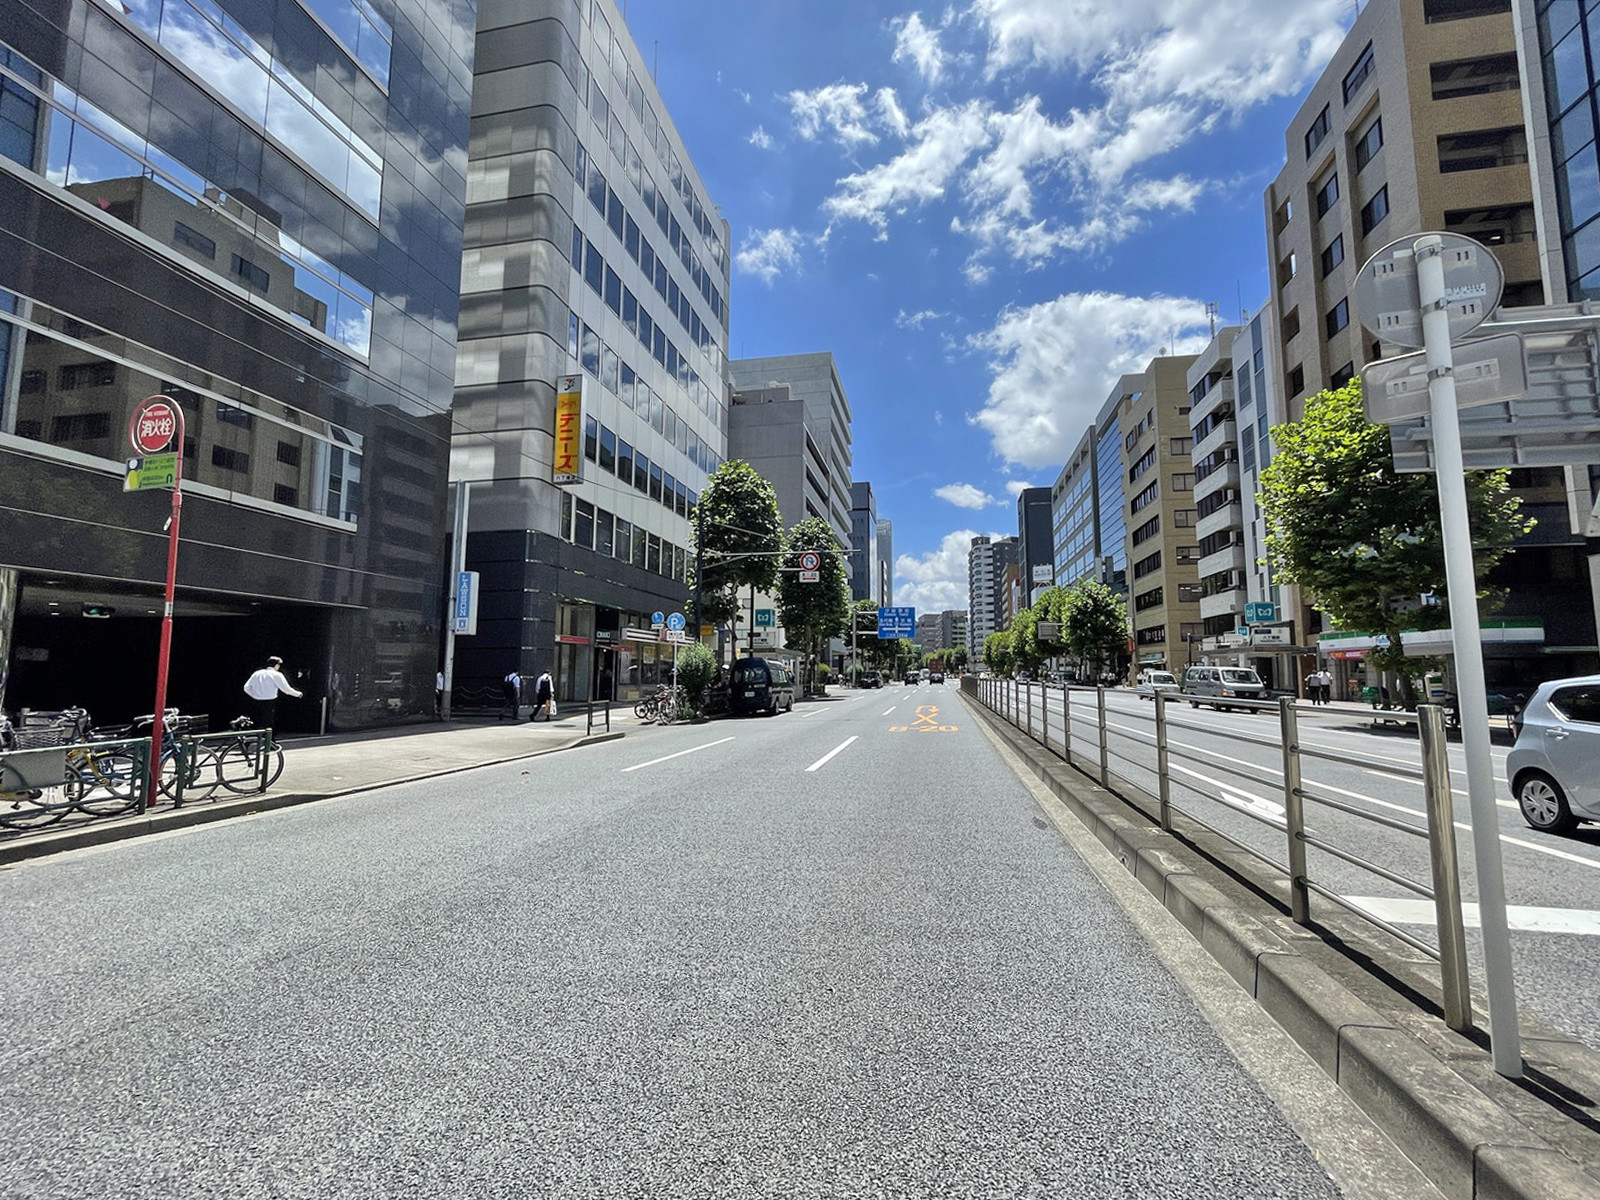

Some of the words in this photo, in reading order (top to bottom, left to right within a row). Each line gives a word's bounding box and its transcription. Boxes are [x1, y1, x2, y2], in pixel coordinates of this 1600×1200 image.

[141, 418, 172, 437] 消火栓
[558, 412, 579, 470] デニーズ
